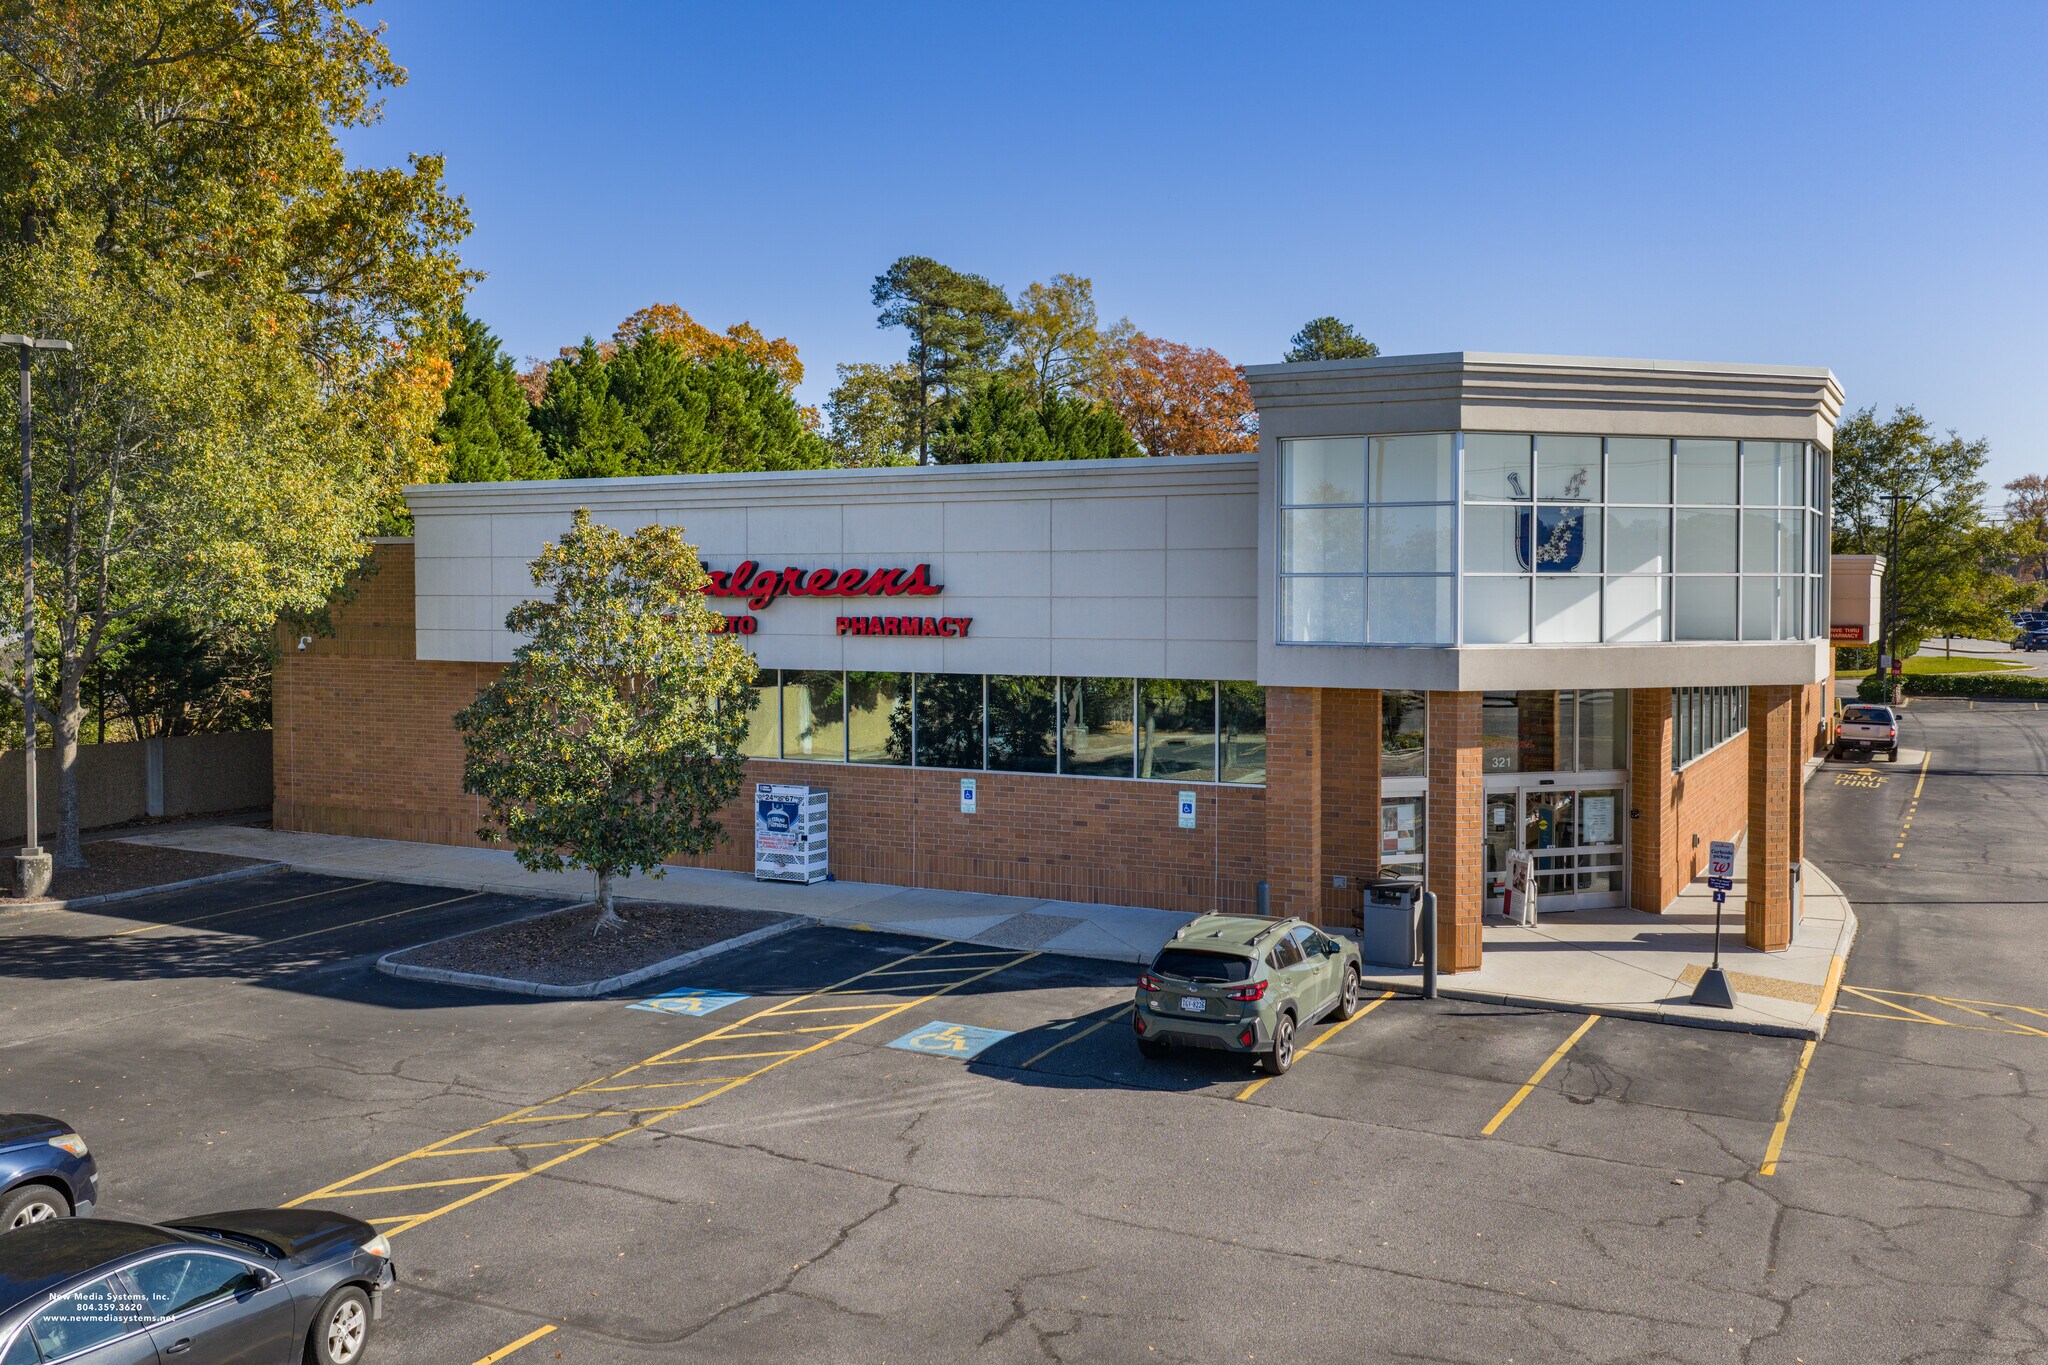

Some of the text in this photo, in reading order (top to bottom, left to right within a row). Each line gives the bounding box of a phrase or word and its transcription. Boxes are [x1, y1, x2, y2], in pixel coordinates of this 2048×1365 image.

[688, 560, 944, 611] algreens
[836, 616, 972, 637] PHARMACY
[1491, 757, 1512, 768] 321
[1834, 778, 1881, 788] THRU
[1836, 773, 1890, 783] DRIVE
[1711, 848, 1734, 856] Curbside
[1716, 893, 1722, 901] 1
